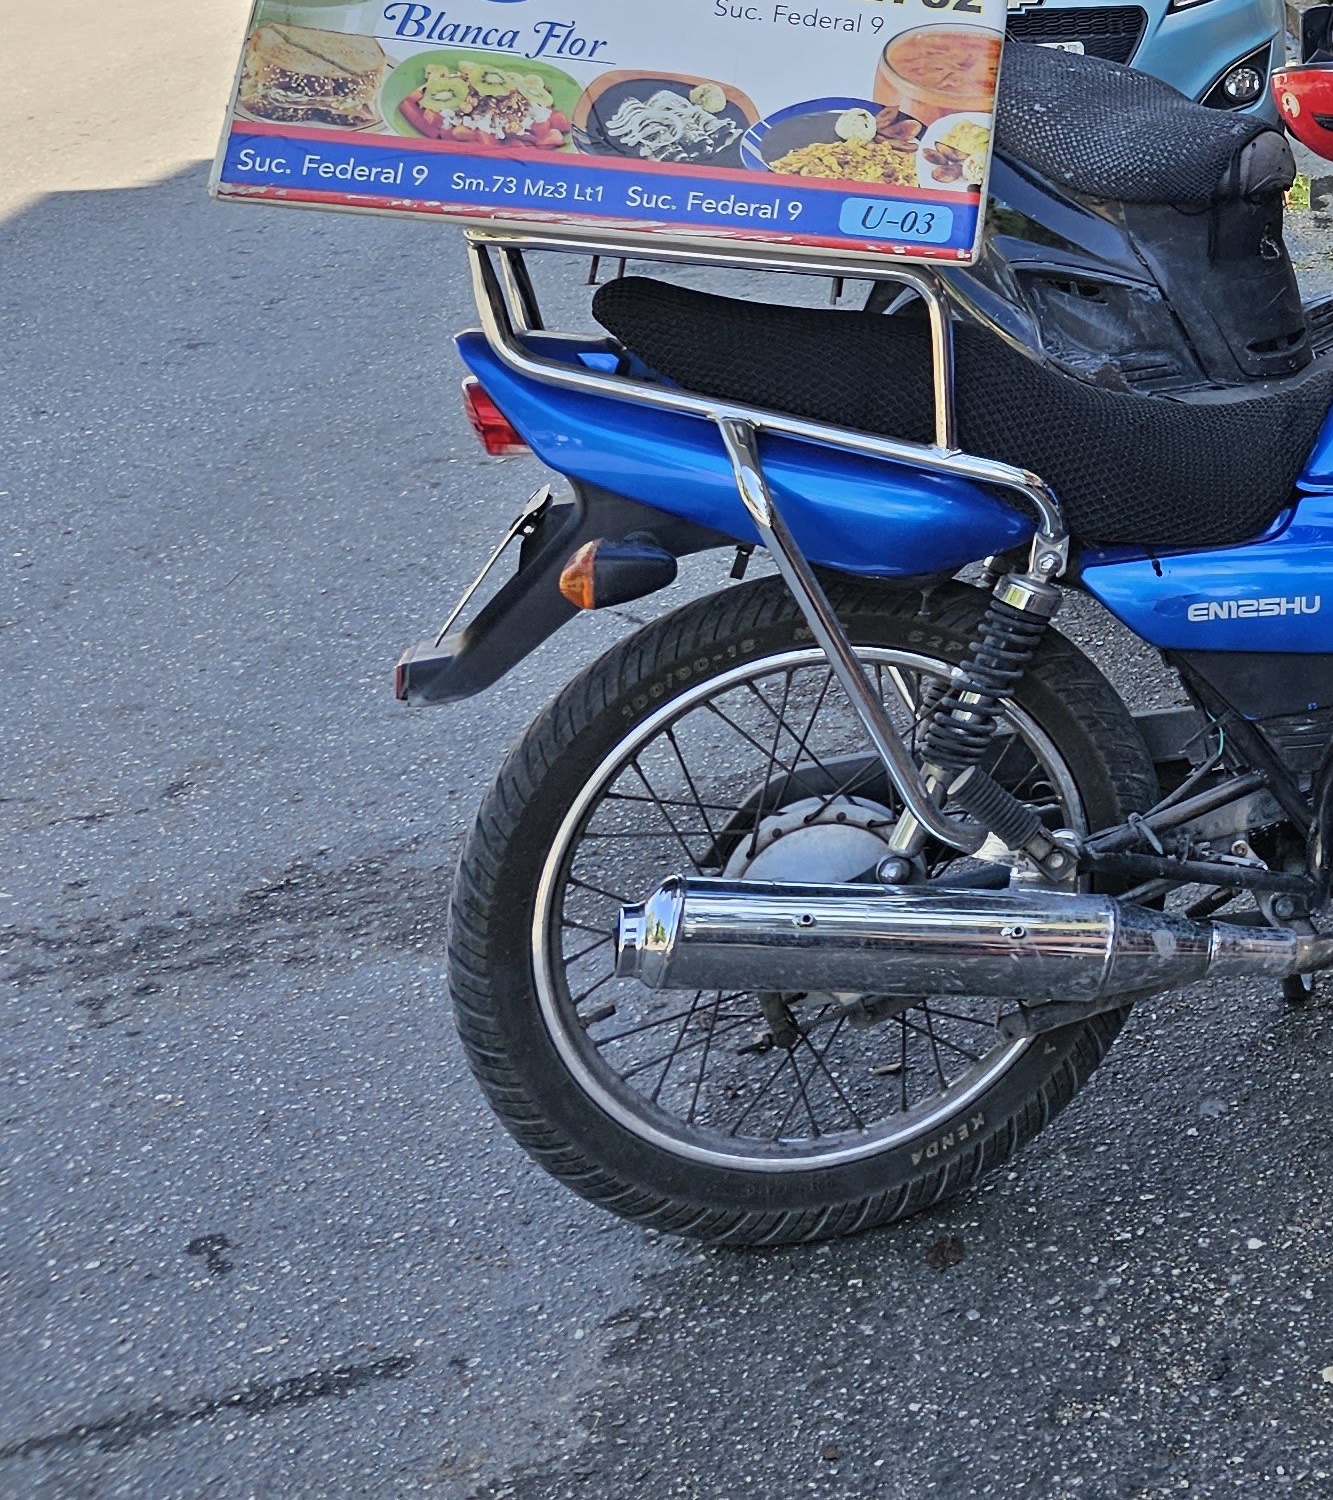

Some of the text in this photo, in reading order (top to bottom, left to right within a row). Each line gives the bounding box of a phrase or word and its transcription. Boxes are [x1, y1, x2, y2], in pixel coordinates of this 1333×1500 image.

[383, 2, 608, 59] Blanca Flor
[773, 4, 862, 33] Federal
[871, 16, 885, 35] 9
[236, 148, 803, 221] Suc. Federal 9 Sm.73 Mz3 Lt1 Suc. Federal 9
[860, 204, 936, 235] U-03
[1187, 595, 1321, 622] EN125HU
[910, 1111, 986, 1158] KENDA
